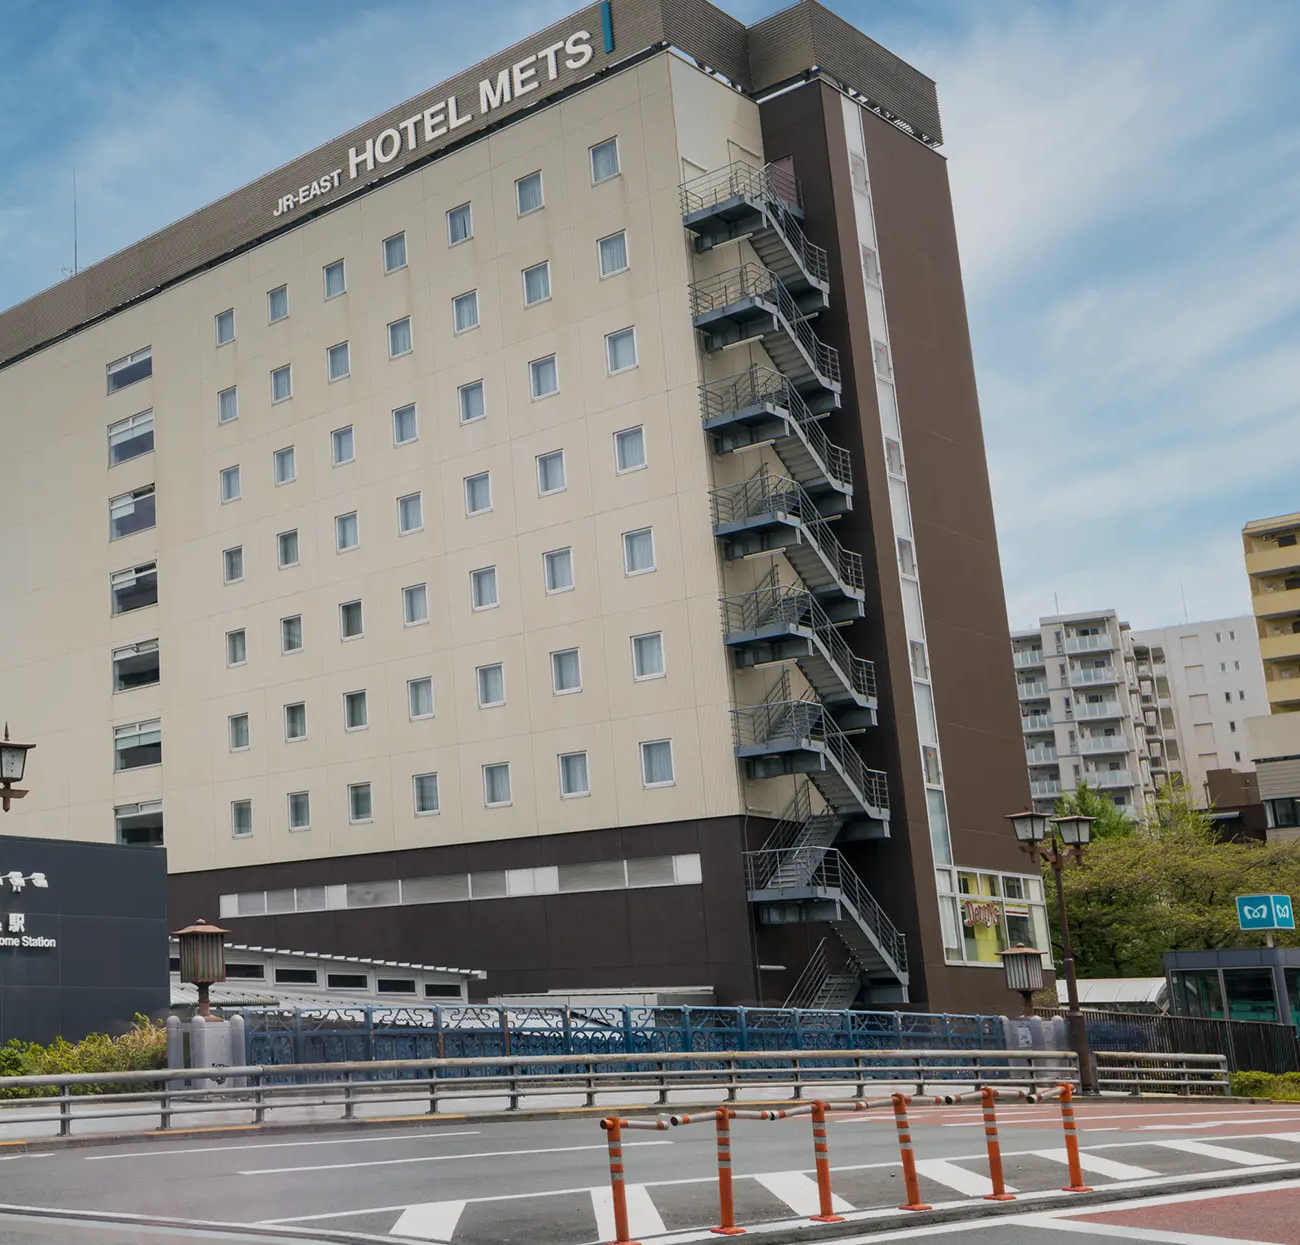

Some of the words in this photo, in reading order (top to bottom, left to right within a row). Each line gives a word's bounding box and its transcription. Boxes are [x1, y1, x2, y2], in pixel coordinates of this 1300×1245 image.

[273, 168, 343, 217] JR-EAST
[348, 96, 473, 180] HOTEL
[479, 30, 595, 115] METS
[21, 935, 56, 948] Station
